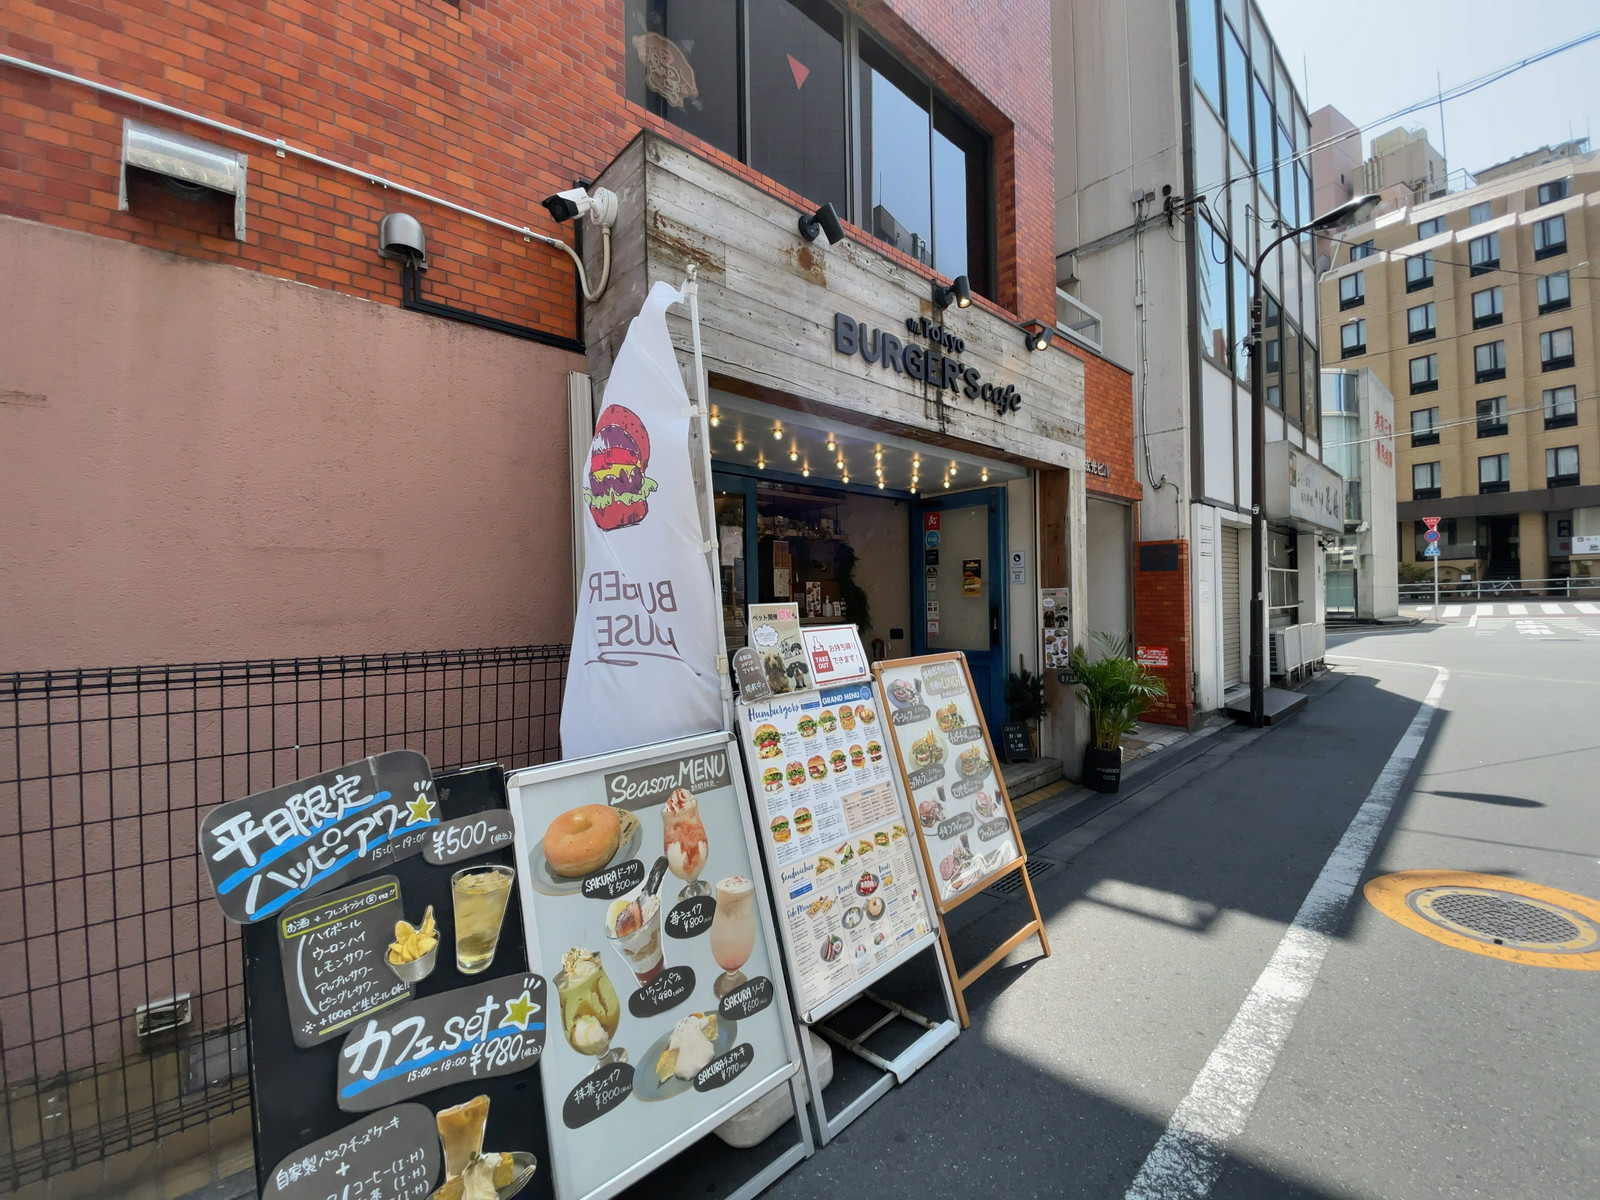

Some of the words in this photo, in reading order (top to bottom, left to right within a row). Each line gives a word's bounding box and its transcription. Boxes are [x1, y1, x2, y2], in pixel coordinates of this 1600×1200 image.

[919, 317, 965, 353] Tokyo
[834, 312, 981, 399] BURGER'S
[822, 695, 843, 704] GRAND
[844, 691, 859, 701] MENU
[610, 775, 678, 805] Season
[678, 754, 725, 786] MENU
[211, 774, 374, 866] 平日限定
[245, 805, 410, 914] ハッピーアワー
[286, 917, 310, 934] お酒
[308, 919, 362, 945] ハイボール
[312, 931, 366, 960] ウーロンハイ
[315, 949, 372, 978] レモンサワー
[315, 966, 374, 994] アップルサワー
[574, 1069, 621, 1104] 抹茶シェイク
[276, 1116, 400, 1191] 自家製バスクチーズケーキ
